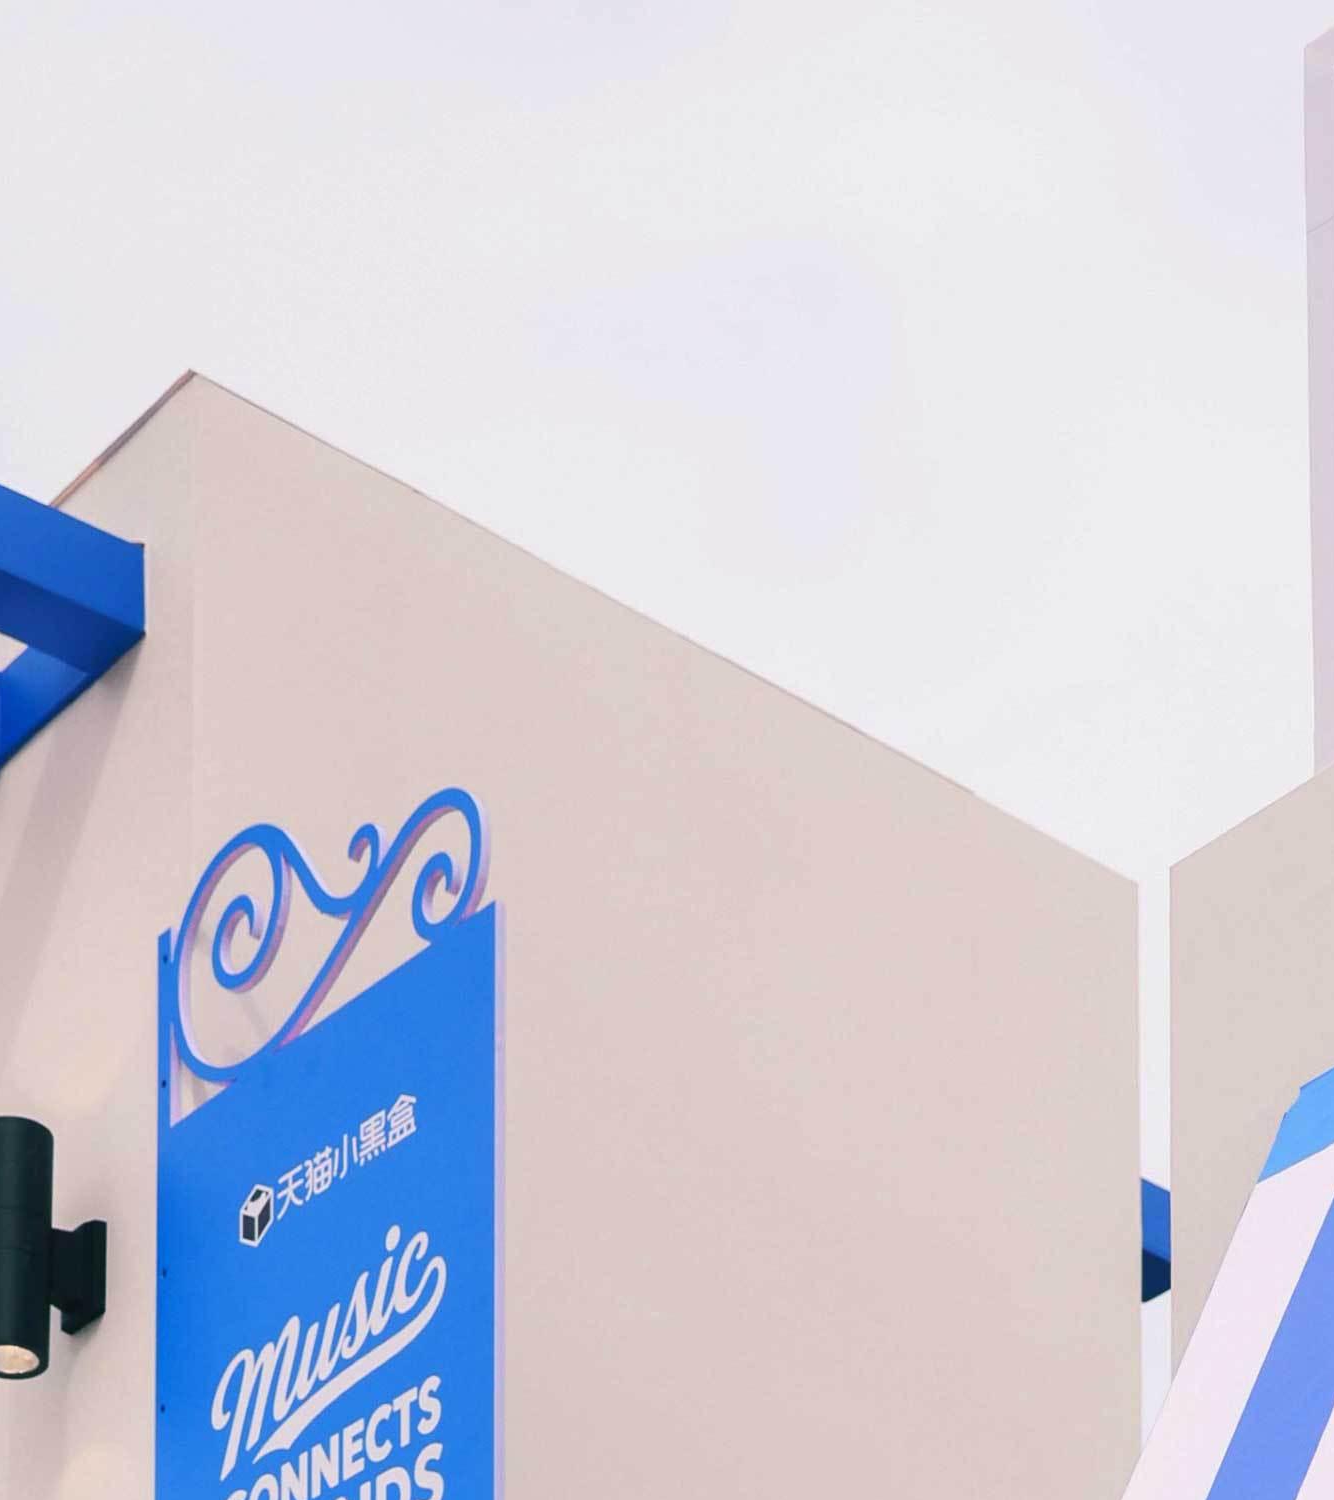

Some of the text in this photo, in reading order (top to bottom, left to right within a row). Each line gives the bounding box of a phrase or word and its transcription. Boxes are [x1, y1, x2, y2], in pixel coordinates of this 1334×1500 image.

[277, 1094, 417, 1221] 天猫小黑盒
[210, 1225, 447, 1482] Music
